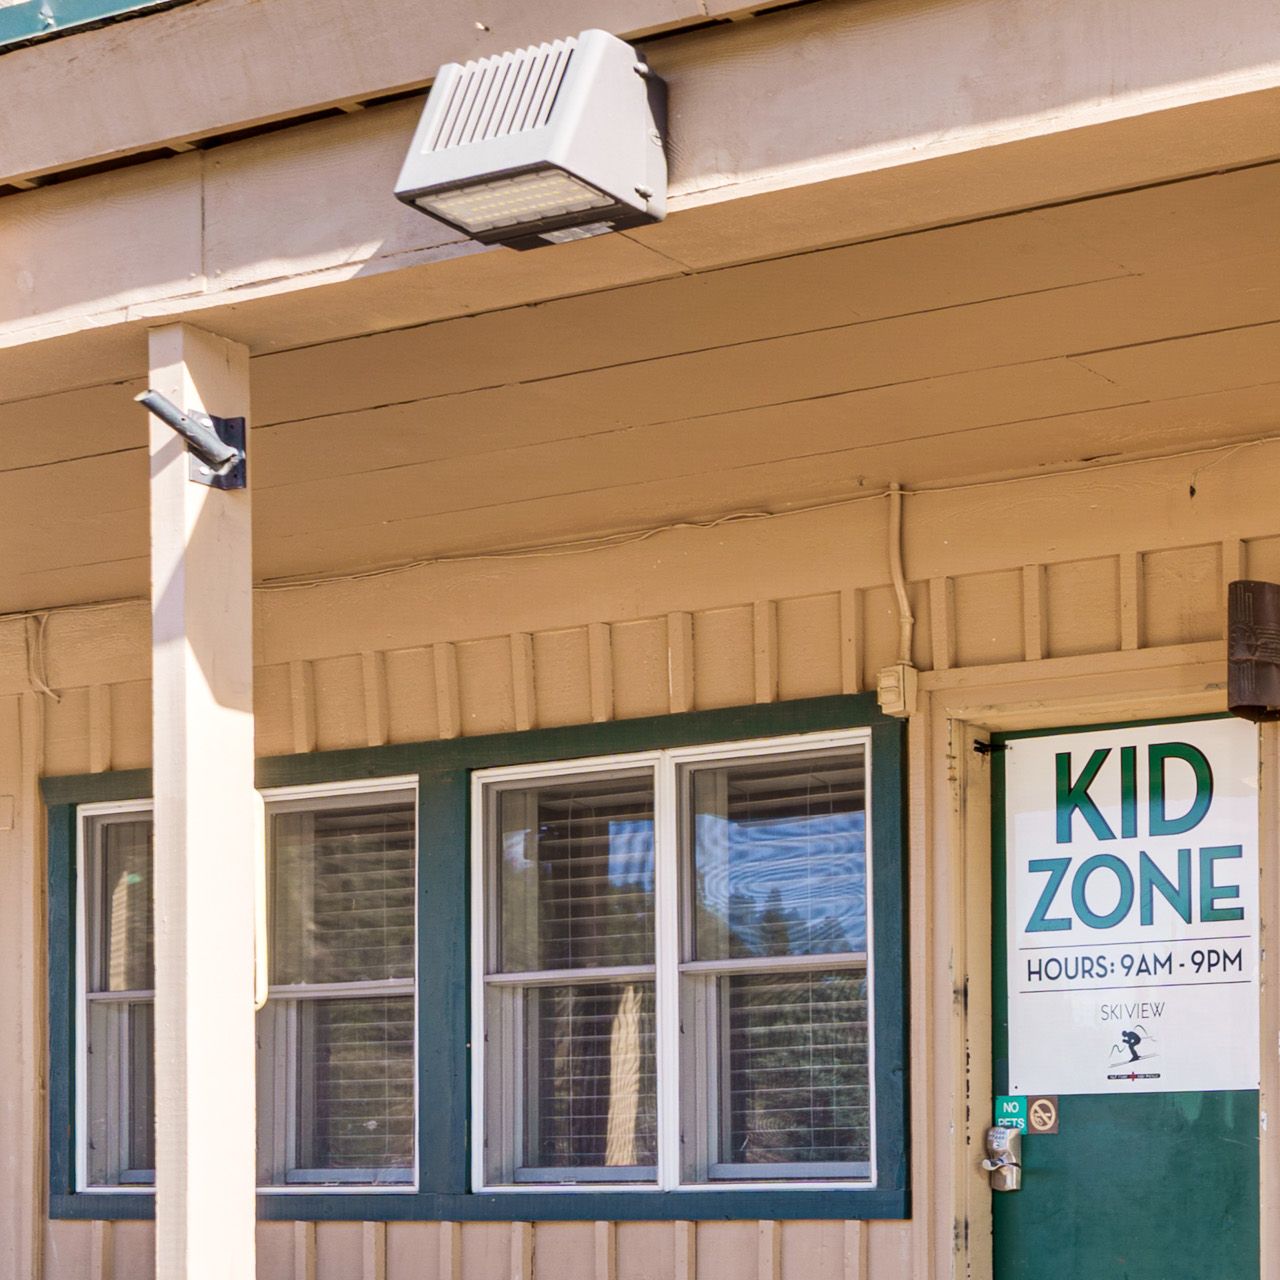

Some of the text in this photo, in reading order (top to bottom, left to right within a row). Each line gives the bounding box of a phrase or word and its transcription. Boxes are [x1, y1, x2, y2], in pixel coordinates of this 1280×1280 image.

[1055, 741, 1214, 844] KID
[1024, 844, 1245, 933] ZONE
[1027, 955, 1115, 982] HOURS:
[1120, 952, 1173, 977] 9AM
[1190, 948, 1243, 974] 9PM
[1003, 1102, 1019, 1113] NO
